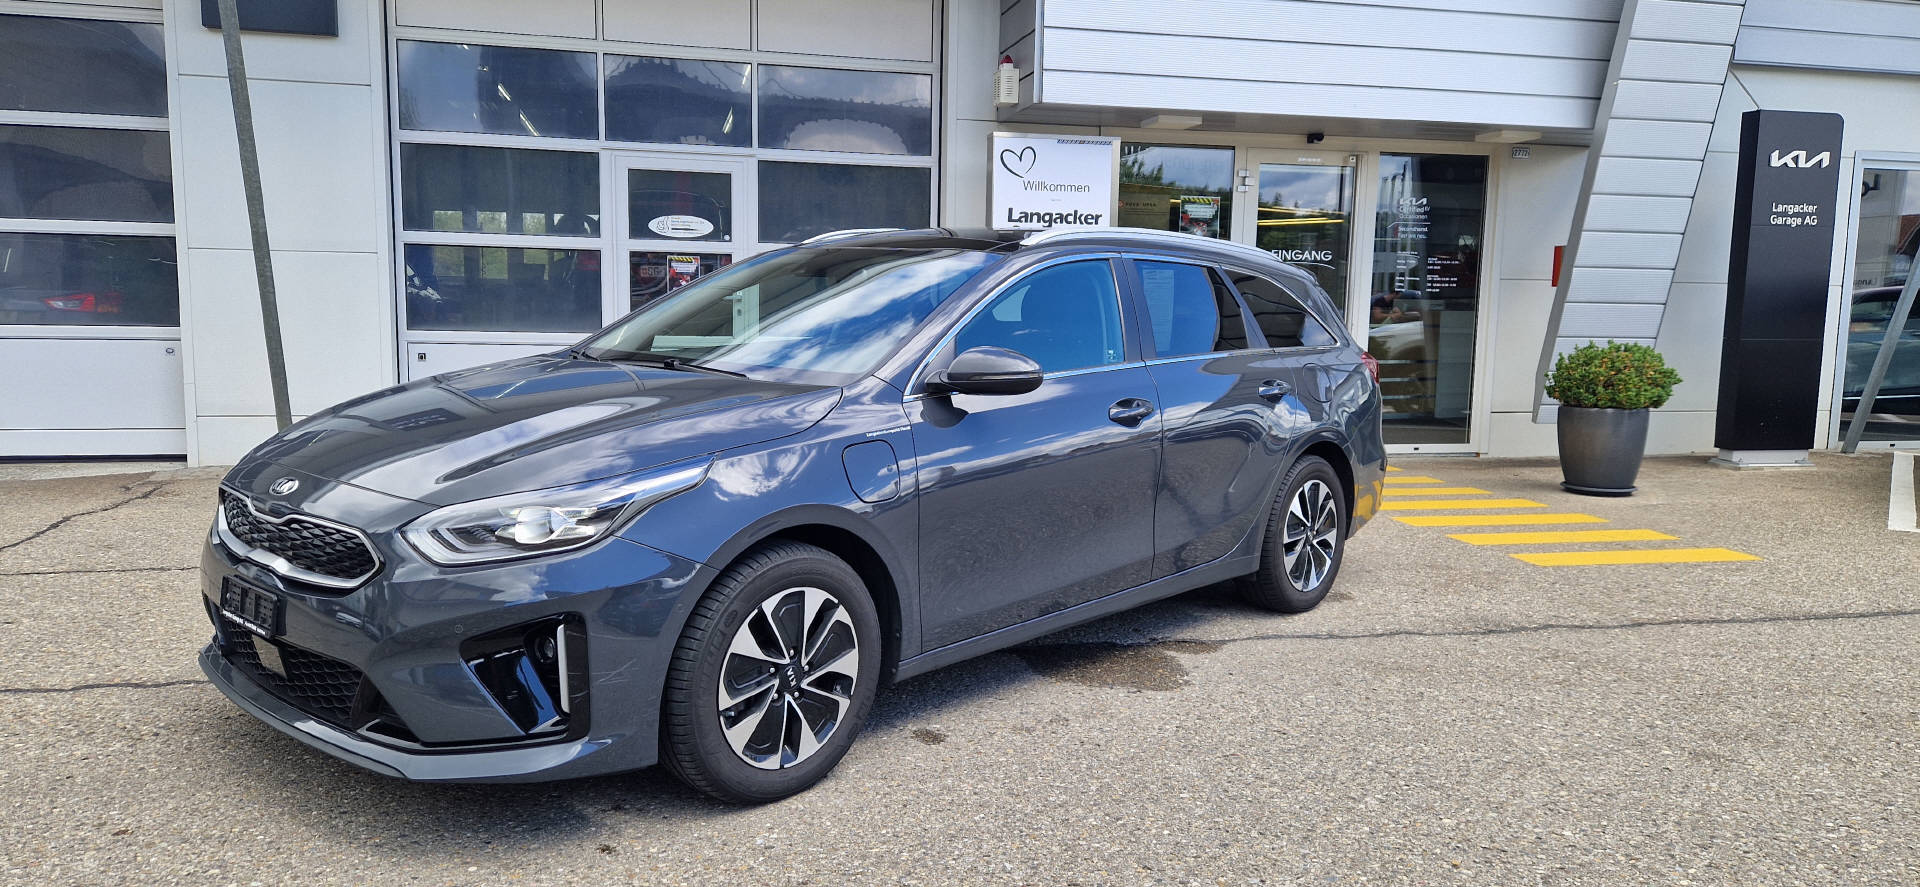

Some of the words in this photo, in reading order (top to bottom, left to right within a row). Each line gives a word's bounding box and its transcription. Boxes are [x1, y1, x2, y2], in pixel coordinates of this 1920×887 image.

[1770, 150, 1831, 168] KIA
[1023, 180, 1091, 193] Willkommen
[1772, 203, 1817, 214] Langacker
[1008, 207, 1103, 228] Langacker
[1770, 215, 1802, 228] Garage
[1804, 216, 1818, 226] AG
[787, 666, 798, 688] KIA
